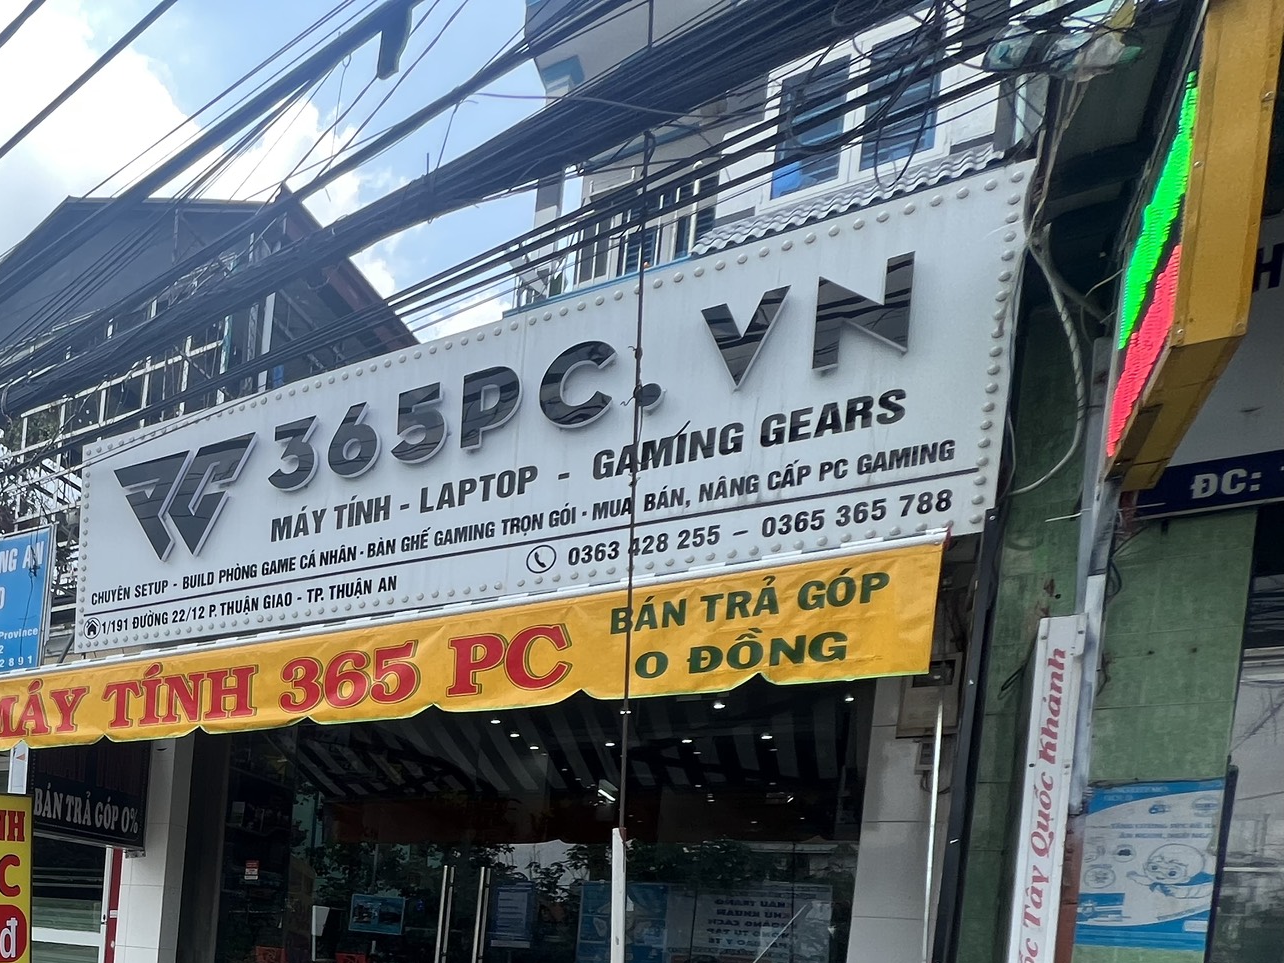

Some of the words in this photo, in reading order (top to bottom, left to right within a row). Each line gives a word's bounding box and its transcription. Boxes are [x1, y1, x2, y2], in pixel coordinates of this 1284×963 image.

[271, 503, 328, 542] MÁY
[334, 494, 392, 529] TÍNH
[420, 465, 539, 513] LAPTOP
[760, 388, 908, 448] GEARS
[1190, 468, 1262, 500] ĐC:
[22, 540, 45, 570] AN
[91, 583, 131, 606] CHUYÊN
[134, 579, 169, 599] SETUP
[182, 572, 215, 591] BUILD
[218, 561, 258, 585] PHÒNG
[261, 557, 297, 577] GAME
[299, 547, 317, 571] CÁ
[319, 544, 358, 567] NHÂN
[366, 537, 397, 559] BÀN
[401, 526, 431, 553] GHẾ
[434, 524, 495, 548] GAMING
[501, 513, 544, 539] TRỌN
[548, 502, 577, 529] GÓI
[592, 497, 634, 521] MUA
[644, 484, 691, 513] BÁN,
[699, 473, 760, 503] NÂNG
[767, 462, 812, 490] CẤP
[819, 460, 849, 483] PC
[856, 439, 957, 476] GAMING
[568, 540, 620, 566] 0363
[627, 530, 669, 557] 428
[677, 524, 721, 549] 255
[761, 508, 826, 539] 0365
[835, 498, 887, 525] 365
[899, 488, 953, 518] 788
[101, 615, 129, 635] 1/191
[131, 605, 169, 630] ĐƯỜNG
[171, 604, 205, 624] 22/12
[207, 601, 218, 619] P.
[219, 591, 260, 617] THUẬN
[262, 587, 293, 609] GIAO
[306, 585, 326, 604] TP.
[328, 577, 374, 602] THUẬN
[377, 575, 398, 593] AN
[610, 595, 687, 635] BÁN
[700, 575, 779, 623] TRẢ
[797, 567, 891, 611] GÓP
[101, 662, 259, 730] TÍNH
[277, 640, 422, 715] 365
[446, 622, 575, 699] PC
[686, 627, 849, 675] ĐỒNG
[66, 790, 92, 826] TRẢ
[95, 796, 119, 831] GÓP
[1030, 771, 1055, 859] Quốc
[1023, 864, 1050, 928] Tây
